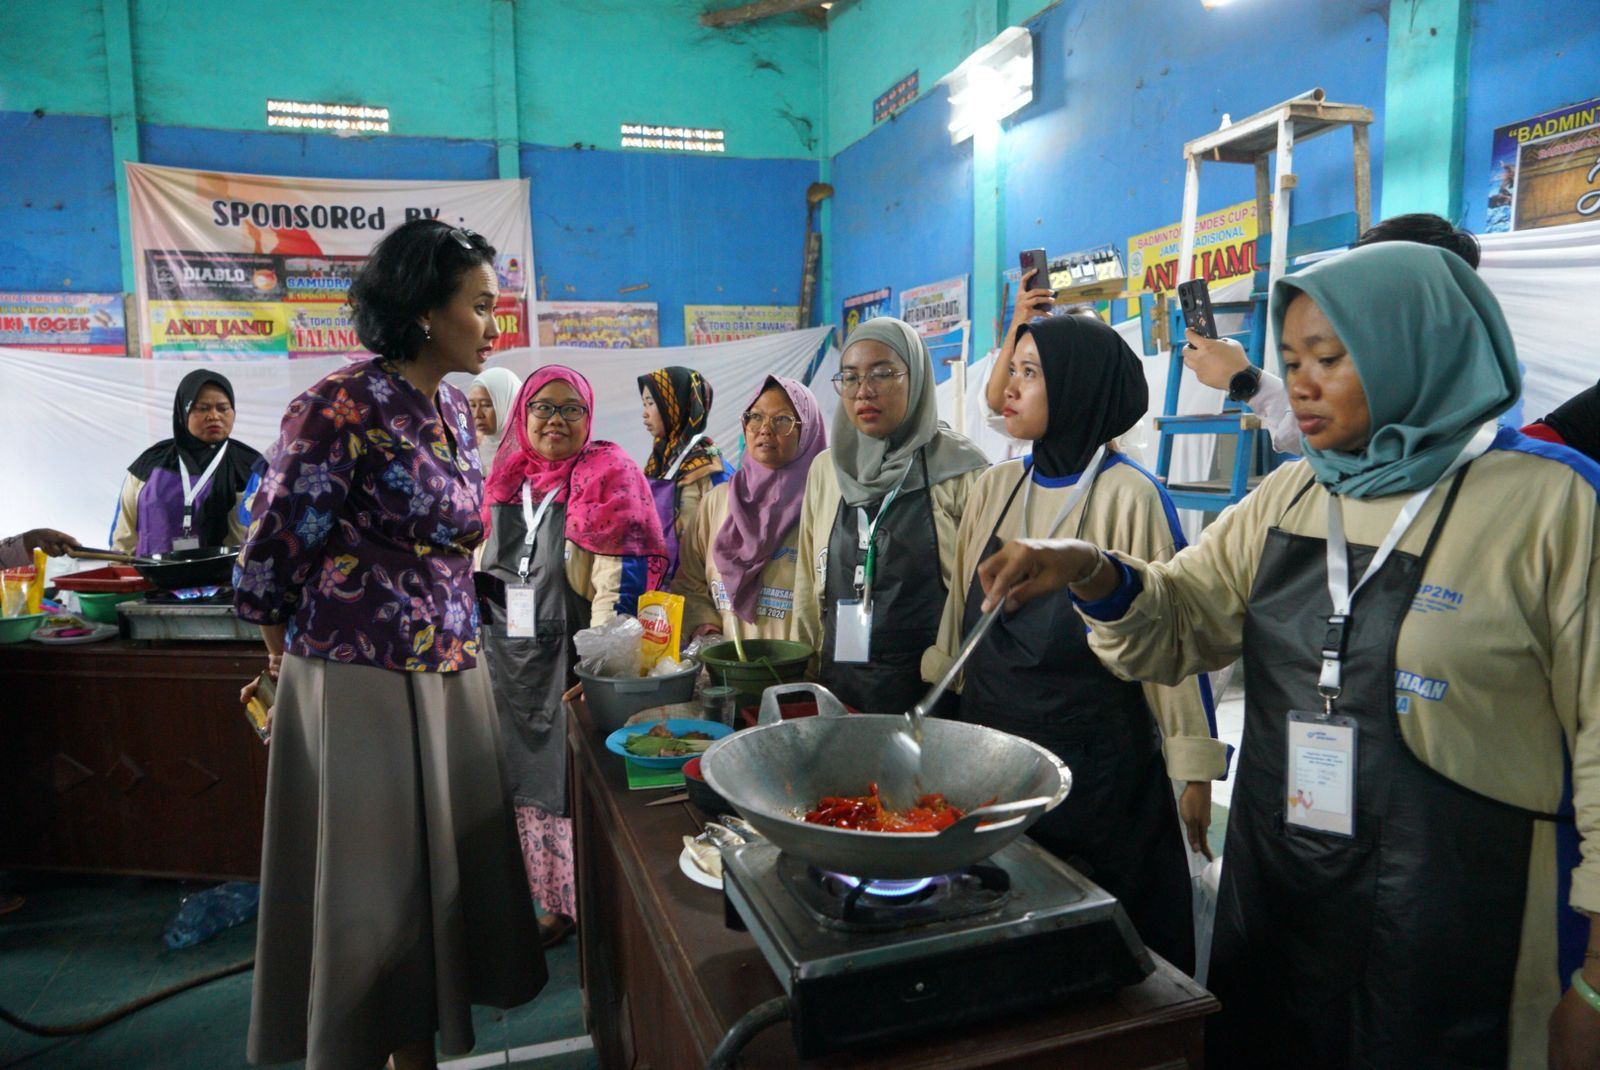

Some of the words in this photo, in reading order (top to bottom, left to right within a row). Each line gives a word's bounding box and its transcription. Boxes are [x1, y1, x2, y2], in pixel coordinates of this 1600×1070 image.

[1508, 107, 1600, 143] “BADMIN
[1195, 215, 1226, 234] EMDES
[1228, 206, 1249, 224] CUP
[183, 267, 246, 282] DIABLO
[27, 316, 91, 332] TOGEK
[310, 317, 332, 327] TOKO
[495, 314, 519, 334] OR
[767, 608, 785, 619] 2024
